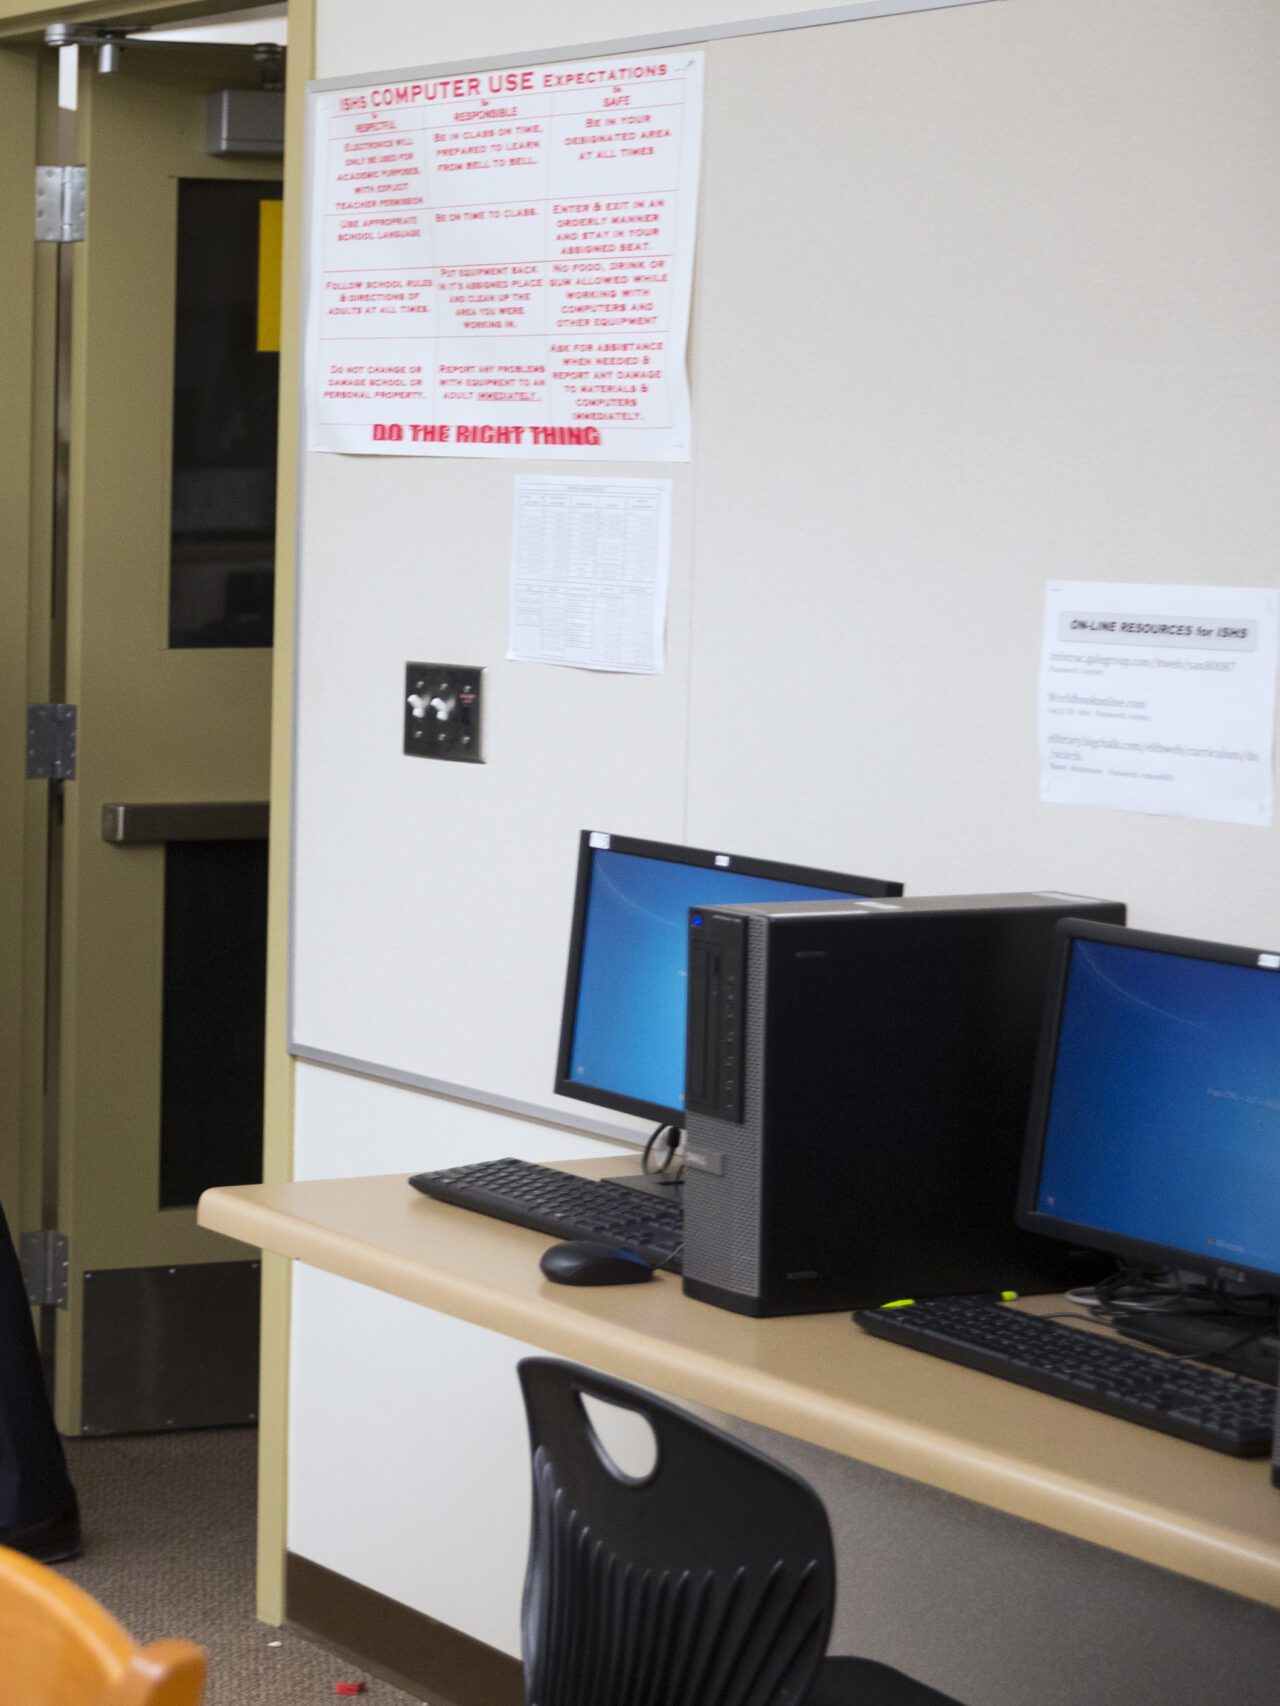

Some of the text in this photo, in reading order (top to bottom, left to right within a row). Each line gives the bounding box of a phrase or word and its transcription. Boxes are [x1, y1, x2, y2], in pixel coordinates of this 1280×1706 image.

[371, 78, 480, 107] COMPUTER
[489, 72, 534, 93] USE
[543, 64, 667, 87] EXPECTATIONS
[604, 96, 631, 107] SAFE
[585, 118, 600, 128] BE
[621, 115, 651, 124] YOUR
[434, 133, 447, 142] BE
[449, 133, 459, 141] IN
[463, 129, 494, 140] CLASS
[564, 130, 670, 145] DESIGNATED AREA
[437, 145, 487, 156] PREPARED
[506, 141, 540, 150] LEARN
[579, 152, 592, 160] AT
[596, 150, 616, 159] ALL
[437, 163, 463, 171] FROM
[466, 161, 489, 169] BELL
[337, 171, 379, 181] ACADEMIC
[336, 201, 376, 209] TEACHER
[552, 205, 589, 214] ENTER
[605, 202, 629, 210] EXIT
[435, 214, 446, 222] BE
[449, 213, 461, 221] ON
[464, 212, 485, 220] TIME
[488, 210, 501, 218] TO
[556, 214, 659, 228] ORDERLY MANNER
[341, 217, 418, 228] USE APPROPRIATE
[338, 230, 421, 241] SCHOOL LANGUAGE
[555, 233, 578, 241] AND
[582, 231, 609, 240] STAY
[628, 228, 659, 237] YOUR
[561, 244, 615, 254] ASSIGNED
[458, 267, 509, 276] EQUIPMENT
[512, 266, 537, 274] BACK
[553, 264, 569, 273] NO
[609, 261, 645, 271] DRINK
[649, 260, 665, 268] OR
[326, 279, 433, 290] FOLLOW SCHOOL RULES
[466, 281, 508, 289] ASSIGNED
[511, 279, 542, 287] PLACE
[549, 274, 668, 287] GUM ALLOWED WHILE
[349, 293, 404, 301] DIRECTIONS
[513, 293, 531, 301] THE
[566, 289, 650, 299] WORKING WITH
[328, 307, 362, 315] ADULTS
[499, 307, 525, 315] WERE
[561, 303, 654, 314] COMPUTERS AND
[463, 321, 502, 329] WORKING
[556, 316, 658, 327] OTHER EQUIPMENT
[550, 344, 569, 352] ASK
[597, 342, 664, 351] ASSISTANCE
[595, 357, 639, 365] NEEDED
[330, 365, 345, 374] DO
[439, 365, 475, 373] REPORT
[498, 365, 545, 373] PROBLEMS
[552, 371, 590, 379] REPORT
[593, 371, 613, 379] ANY
[466, 379, 516, 387] EQUIPMENT
[576, 399, 637, 407] COMPUTERS
[373, 424, 601, 445] DO THE RIGHT THING
[1071, 620, 1117, 632] ON-LINE
[1121, 622, 1193, 636] RESOURCES
[1197, 626, 1214, 637] for
